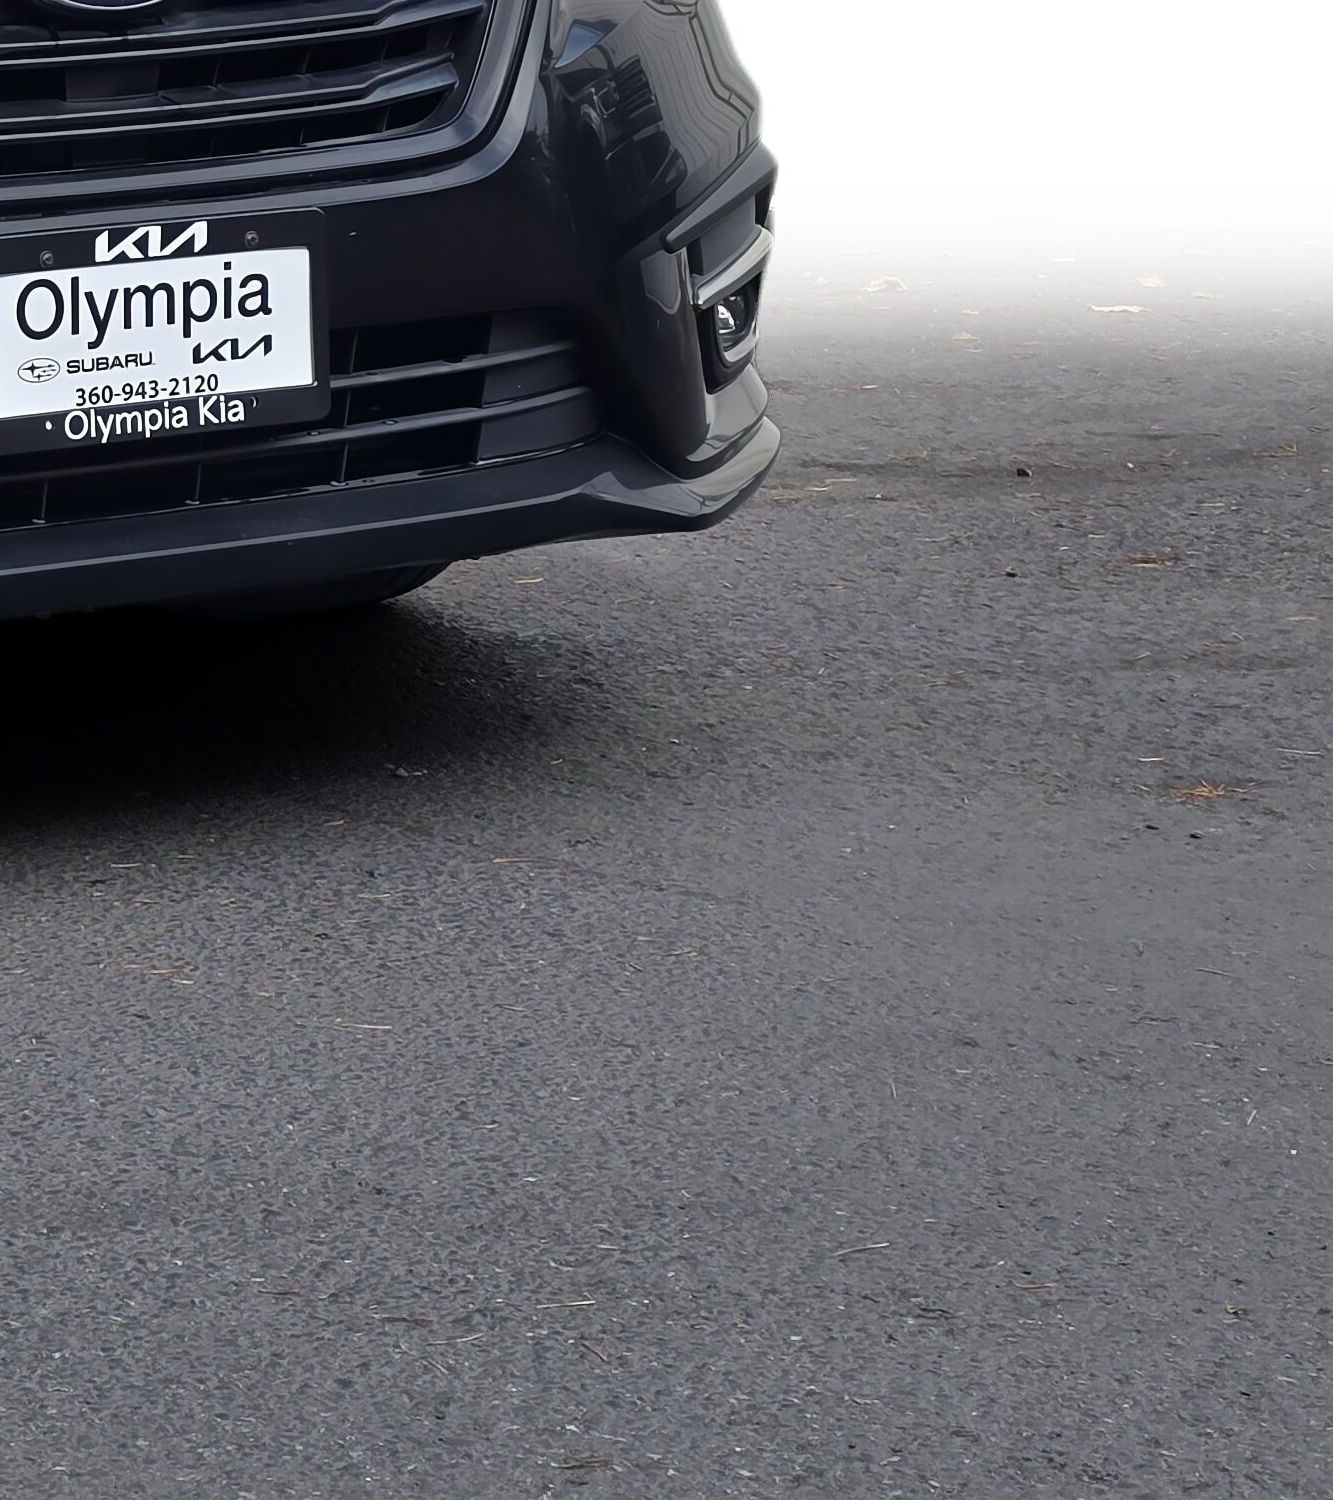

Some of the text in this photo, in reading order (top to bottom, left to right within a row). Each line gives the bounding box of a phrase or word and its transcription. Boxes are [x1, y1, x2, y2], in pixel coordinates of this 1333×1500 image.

[16, 261, 273, 350] Olympia
[75, 373, 219, 407] 360-943-2120
[64, 395, 245, 443] Olympia Kia
